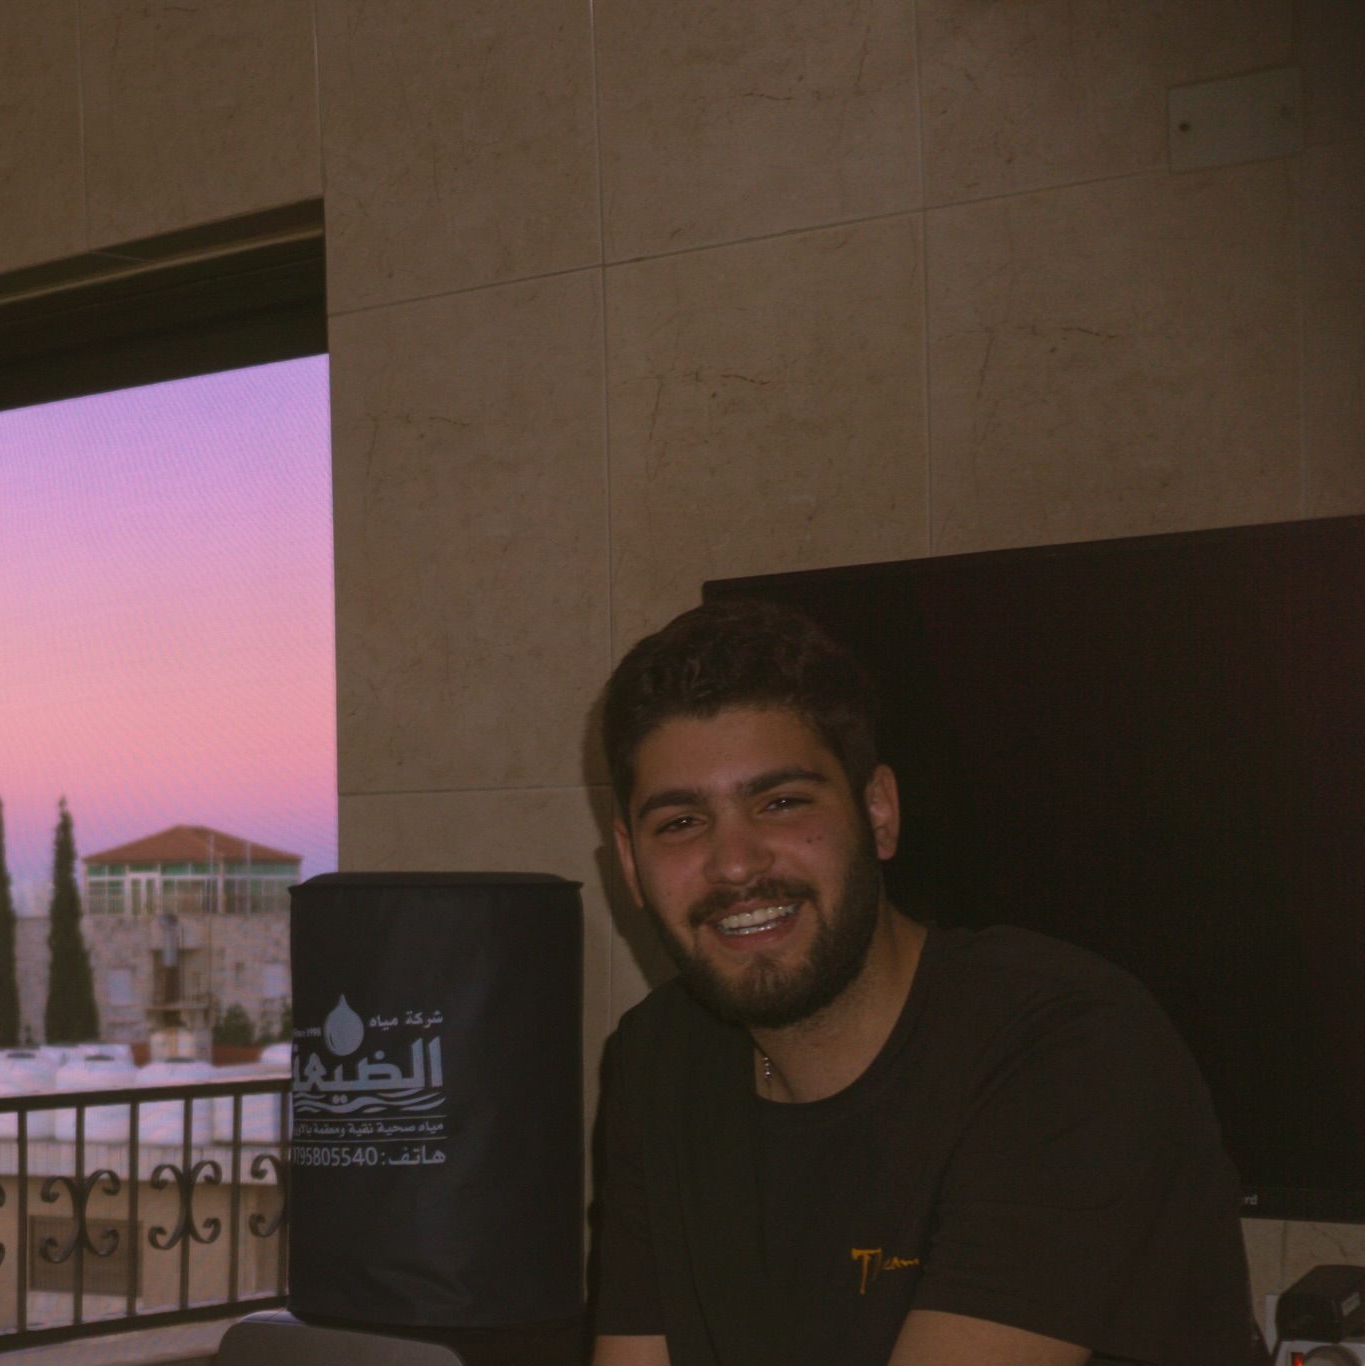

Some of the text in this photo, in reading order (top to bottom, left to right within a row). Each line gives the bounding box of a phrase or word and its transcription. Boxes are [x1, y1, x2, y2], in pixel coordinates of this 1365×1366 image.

[368, 1009, 444, 1031] شركة مياه
[347, 1122, 374, 1137] نقية
[376, 1119, 416, 1137] صحية
[417, 1120, 444, 1135] مياه
